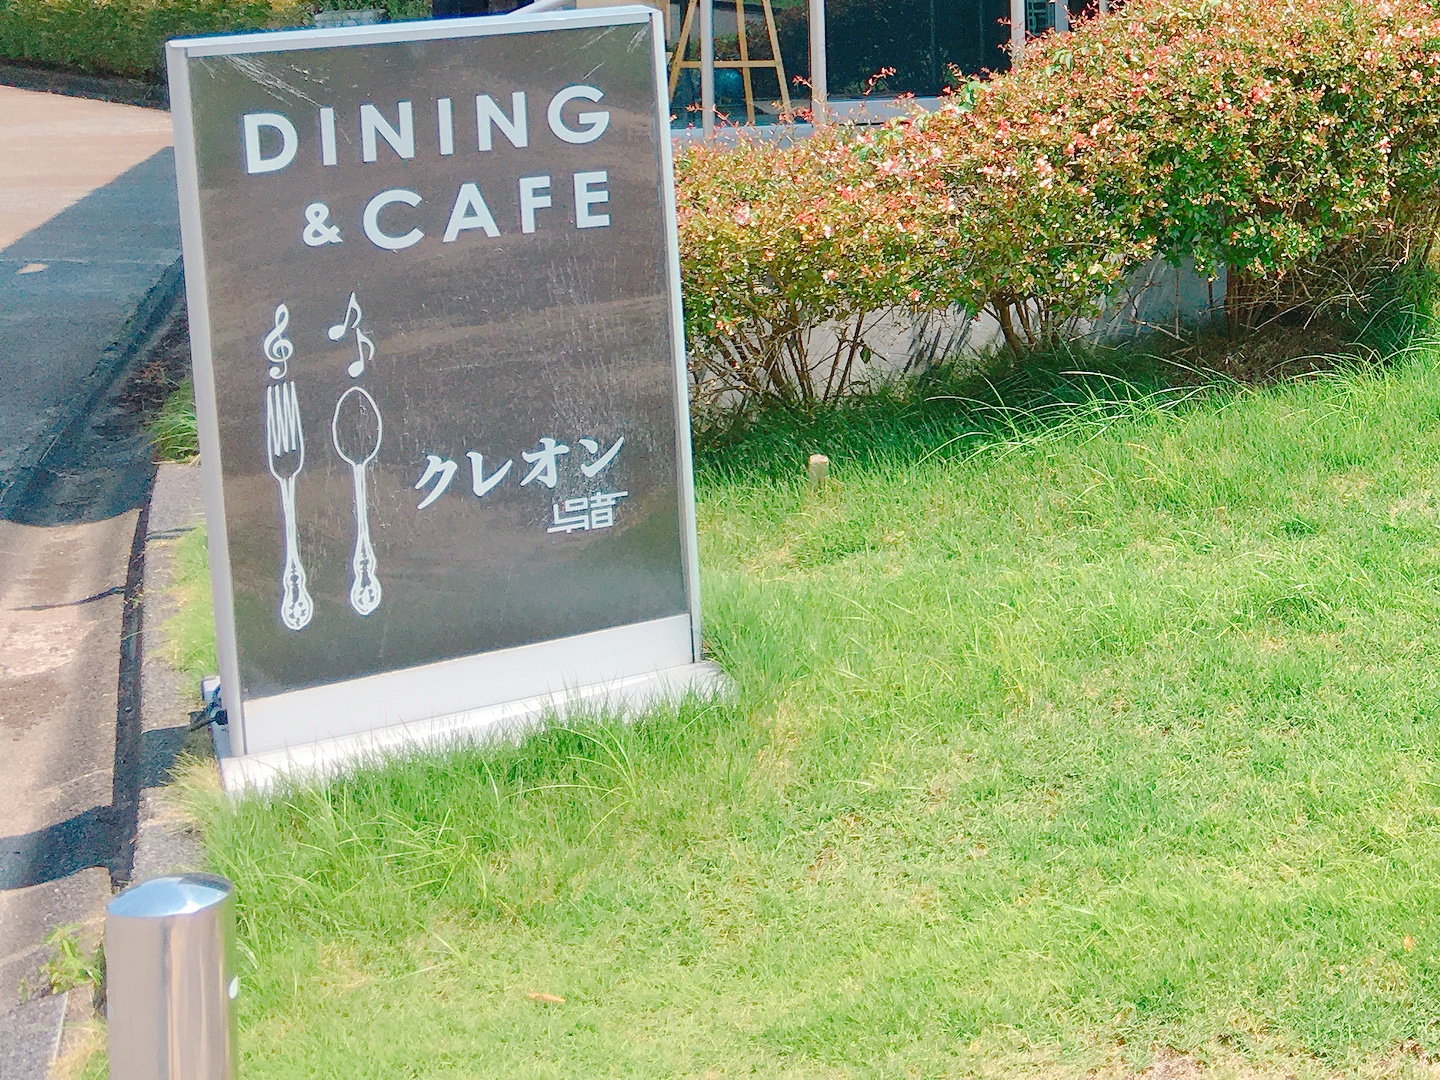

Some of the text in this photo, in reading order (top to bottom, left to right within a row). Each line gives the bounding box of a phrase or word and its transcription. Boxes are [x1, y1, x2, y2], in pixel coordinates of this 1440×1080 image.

[243, 84, 610, 175] DINING
[415, 436, 625, 510] クレオン
